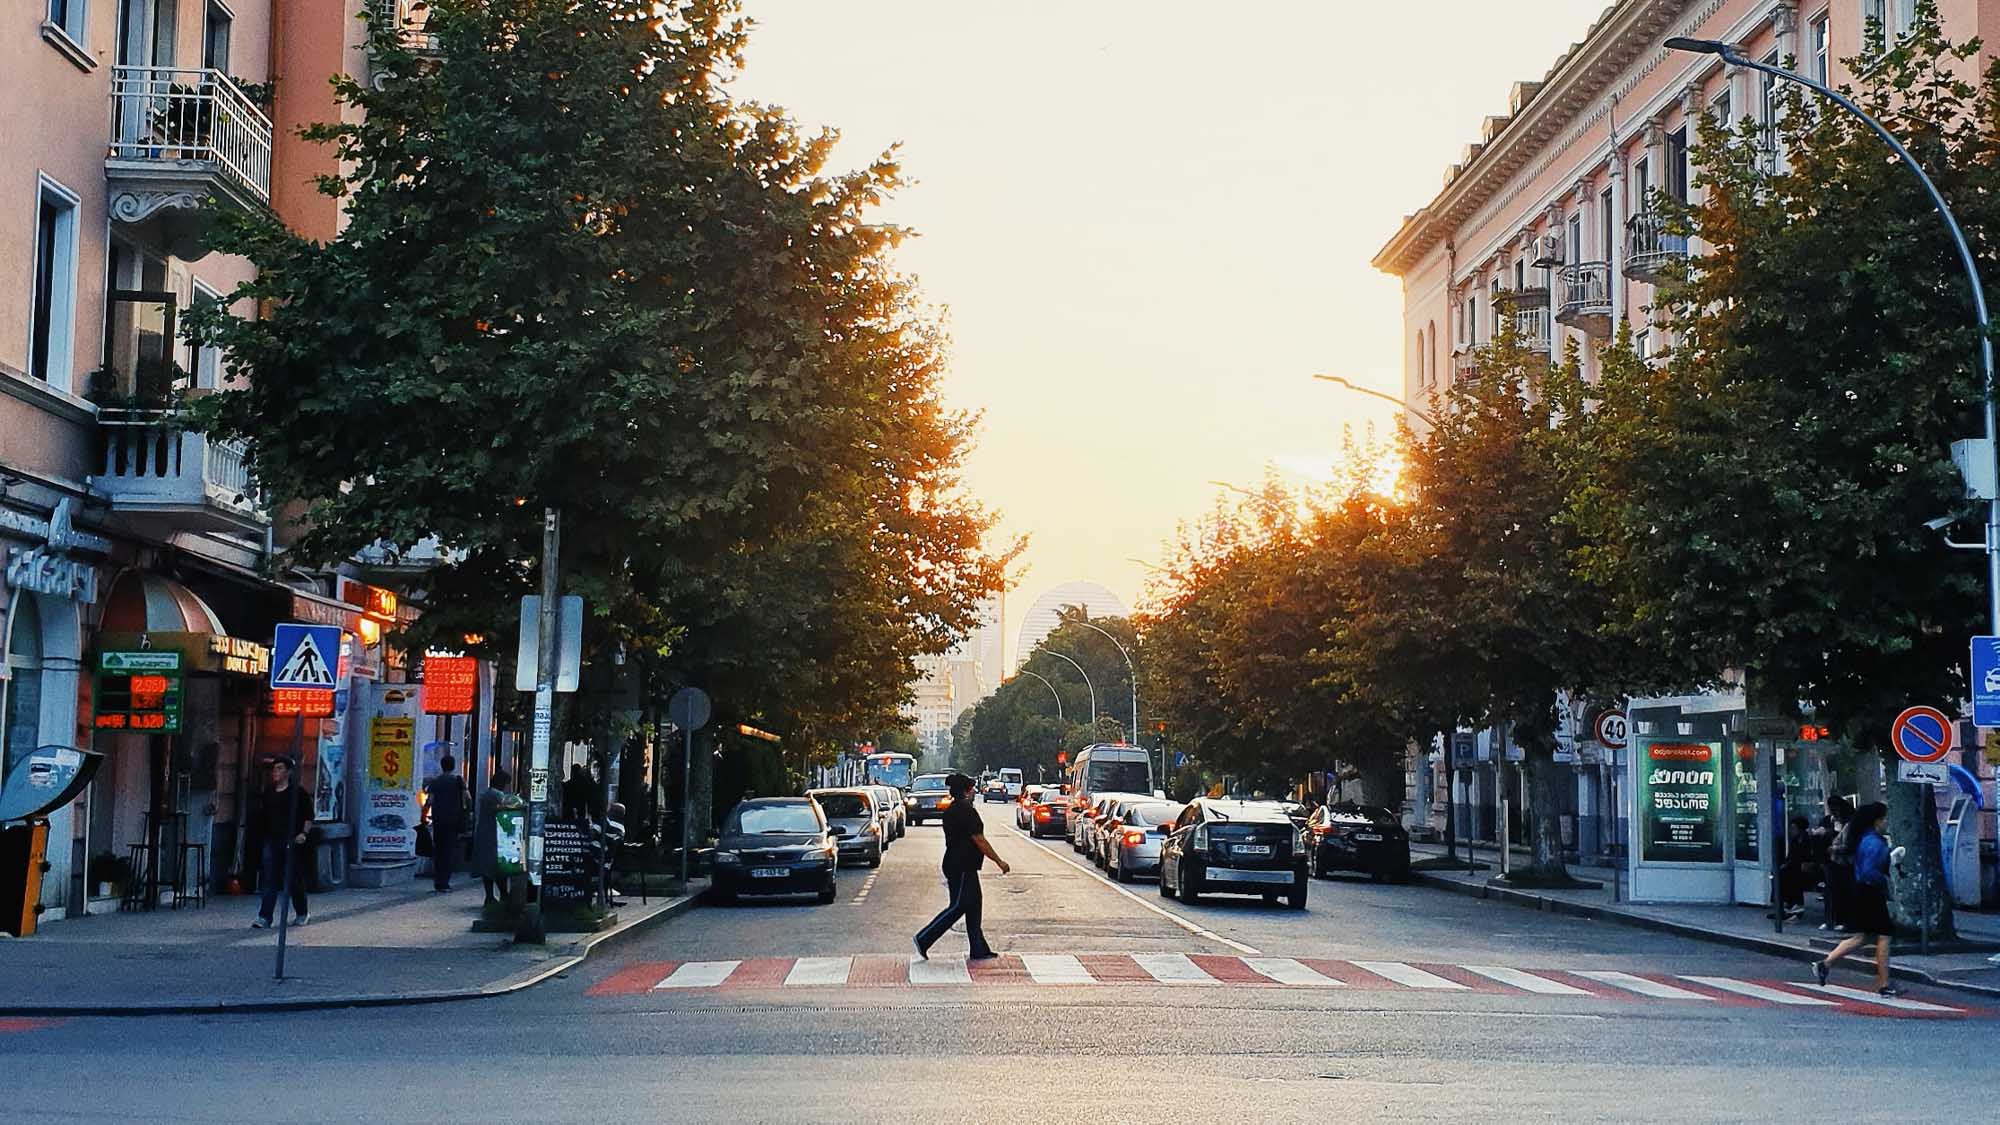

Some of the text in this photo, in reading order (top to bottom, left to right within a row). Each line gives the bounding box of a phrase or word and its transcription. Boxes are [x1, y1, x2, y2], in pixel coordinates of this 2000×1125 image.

[1604, 720, 1626, 740] 40
[1654, 799, 1709, 810] უფასოდ
[544, 831, 580, 839] ESPRESSO
